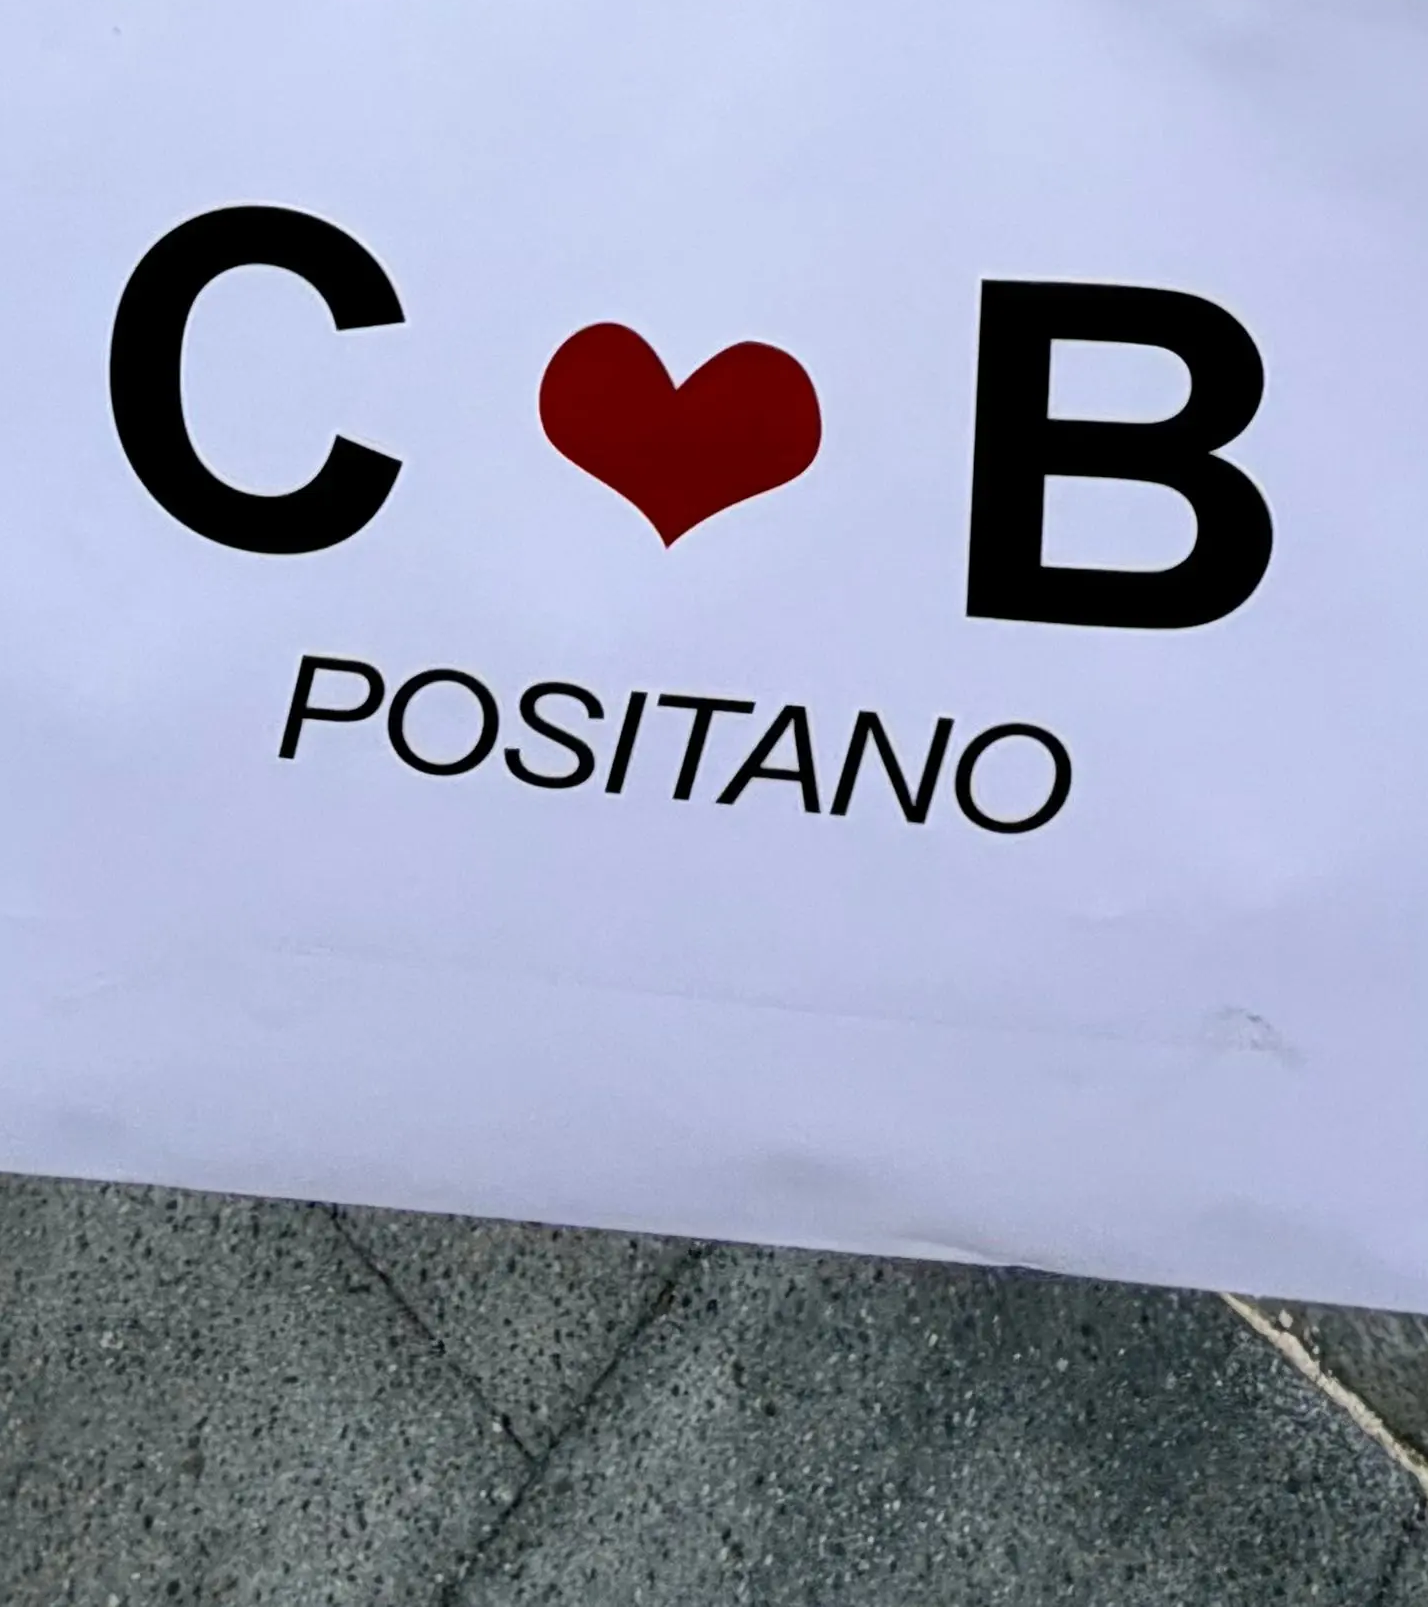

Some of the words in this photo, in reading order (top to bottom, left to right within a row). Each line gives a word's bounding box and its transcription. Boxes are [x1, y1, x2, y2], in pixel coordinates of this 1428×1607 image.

[109, 204, 406, 555] C
[965, 277, 1276, 631] B
[277, 653, 1075, 836] POSITANO
